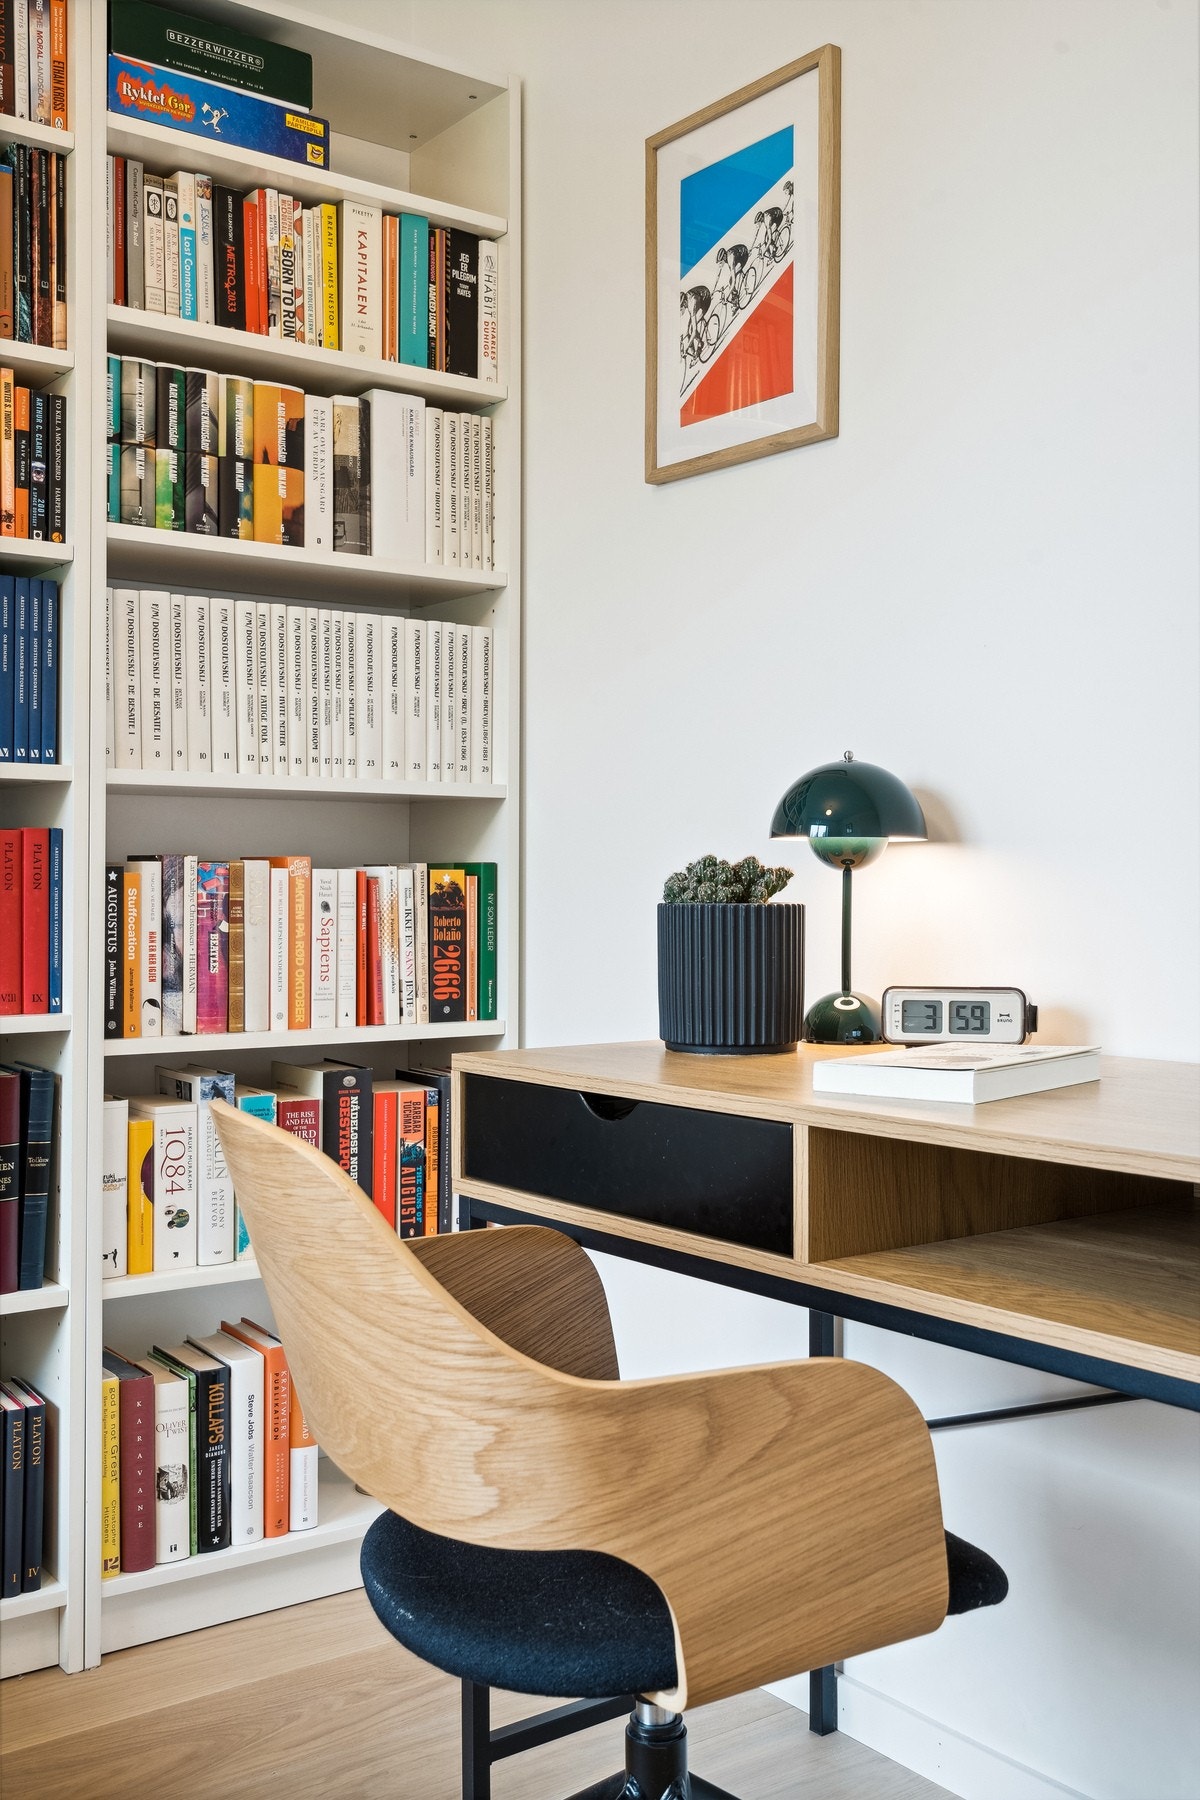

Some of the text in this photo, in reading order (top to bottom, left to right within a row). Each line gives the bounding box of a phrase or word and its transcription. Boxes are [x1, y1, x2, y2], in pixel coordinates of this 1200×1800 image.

[36, 14, 44, 28] THE
[17, 32, 26, 82] WAKING
[36, 30, 44, 59] MORAL
[36, 61, 44, 108] LANDSCAPE
[53, 60, 64, 83] ETHAN
[17, 88, 26, 104] UP
[53, 86, 64, 112] KROSS
[123, 82, 167, 106] Ryktet
[168, 96, 191, 112] Går
[184, 236, 192, 316] Lost Connections
[226, 246, 236, 312] METRO 2033
[282, 250, 295, 285] BORN
[357, 230, 367, 315] KAPITALEN
[282, 289, 295, 306] TO
[484, 274, 493, 318] HABIT
[282, 310, 295, 338] RUN
[35, 398, 43, 422] ARTHUR
[55, 400, 62, 408] TO
[35, 434, 43, 457] CLARKE
[169, 383, 178, 483] KARL OVE KNAUSGÅRD MIN KAMP
[313, 430, 318, 441] AV
[151, 688, 160, 698] DE
[151, 701, 160, 732] BESATTE
[259, 695, 267, 723] FATTIGE
[259, 725, 267, 743] FOLK
[5, 842, 13, 891] PLATON
[33, 844, 42, 890] PLATON
[295, 878, 304, 919] JAKTEN
[487, 894, 494, 904] NY
[128, 888, 137, 960] Stuffocation
[295, 923, 304, 938] PÅ
[433, 928, 461, 941] Bolaño
[434, 916, 461, 927] Roberto
[108, 886, 117, 1010] AUGUSTUS John Williams
[148, 931, 156, 944] HAN
[316, 918, 333, 982] Sapiens
[148, 954, 156, 964] HER
[210, 934, 218, 974] BEATLES
[295, 941, 304, 965] RØD
[405, 908, 414, 1008] IKKE EN SANN JENTE
[148, 966, 156, 982] IGJEN
[434, 945, 461, 1000] 2666
[1, 994, 16, 1002] VIII
[32, 994, 42, 1002] IX
[295, 970, 304, 1023] OKTOBER
[924, 1004, 936, 1030] 3
[956, 1005, 984, 1030] 59
[350, 1096, 360, 1154] NÅDELØSE
[403, 1101, 412, 1134] TUCHMAN
[412, 1101, 421, 1134] BARBARA
[291, 1130, 316, 1139] HIRD
[340, 1096, 350, 1170] GESTAPO
[160, 1127, 186, 1195] 1Q84
[401, 1167, 416, 1224] AUGUST
[416, 1212, 422, 1223] OF
[110, 1387, 119, 1406] god
[208, 1383, 224, 1444] KOLLAPS
[13, 1421, 22, 1470] PLATON
[32, 1416, 41, 1465] PLATON
[110, 1424, 119, 1440] not
[110, 1445, 119, 1482] Great
[247, 1394, 255, 1510] Steve Jobs Walter Isaacson
[28, 1568, 39, 1577] IV
